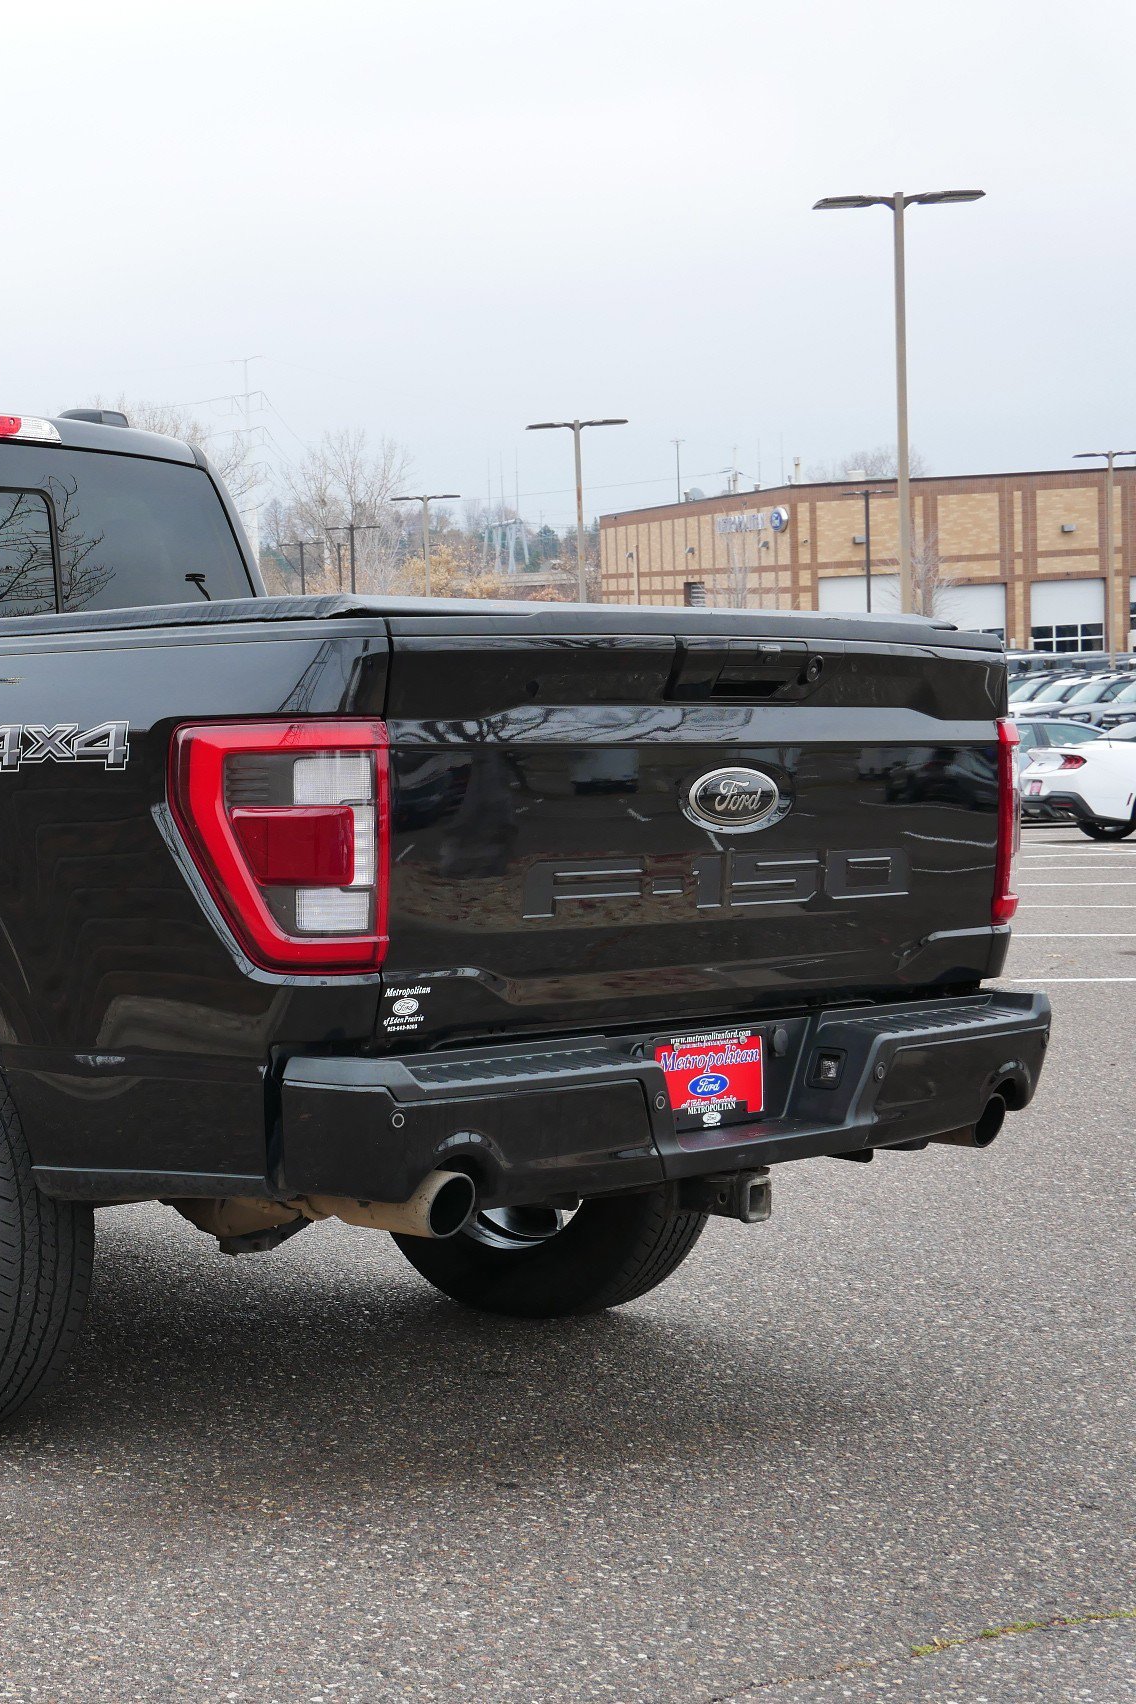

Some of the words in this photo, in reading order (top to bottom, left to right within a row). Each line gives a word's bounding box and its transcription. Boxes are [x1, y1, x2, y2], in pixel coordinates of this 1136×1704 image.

[714, 779, 762, 811] Ford
[521, 848, 911, 919] F-150
[384, 985, 431, 998] Metropolitan
[383, 1017, 390, 1027] of
[404, 1014, 424, 1022] Prairie
[670, 1030, 751, 1044] www.metropolitanford.com
[661, 1045, 759, 1073] Metropolitan
[696, 1077, 721, 1093] Ford
[687, 1101, 736, 1115] METROPOLITAN
